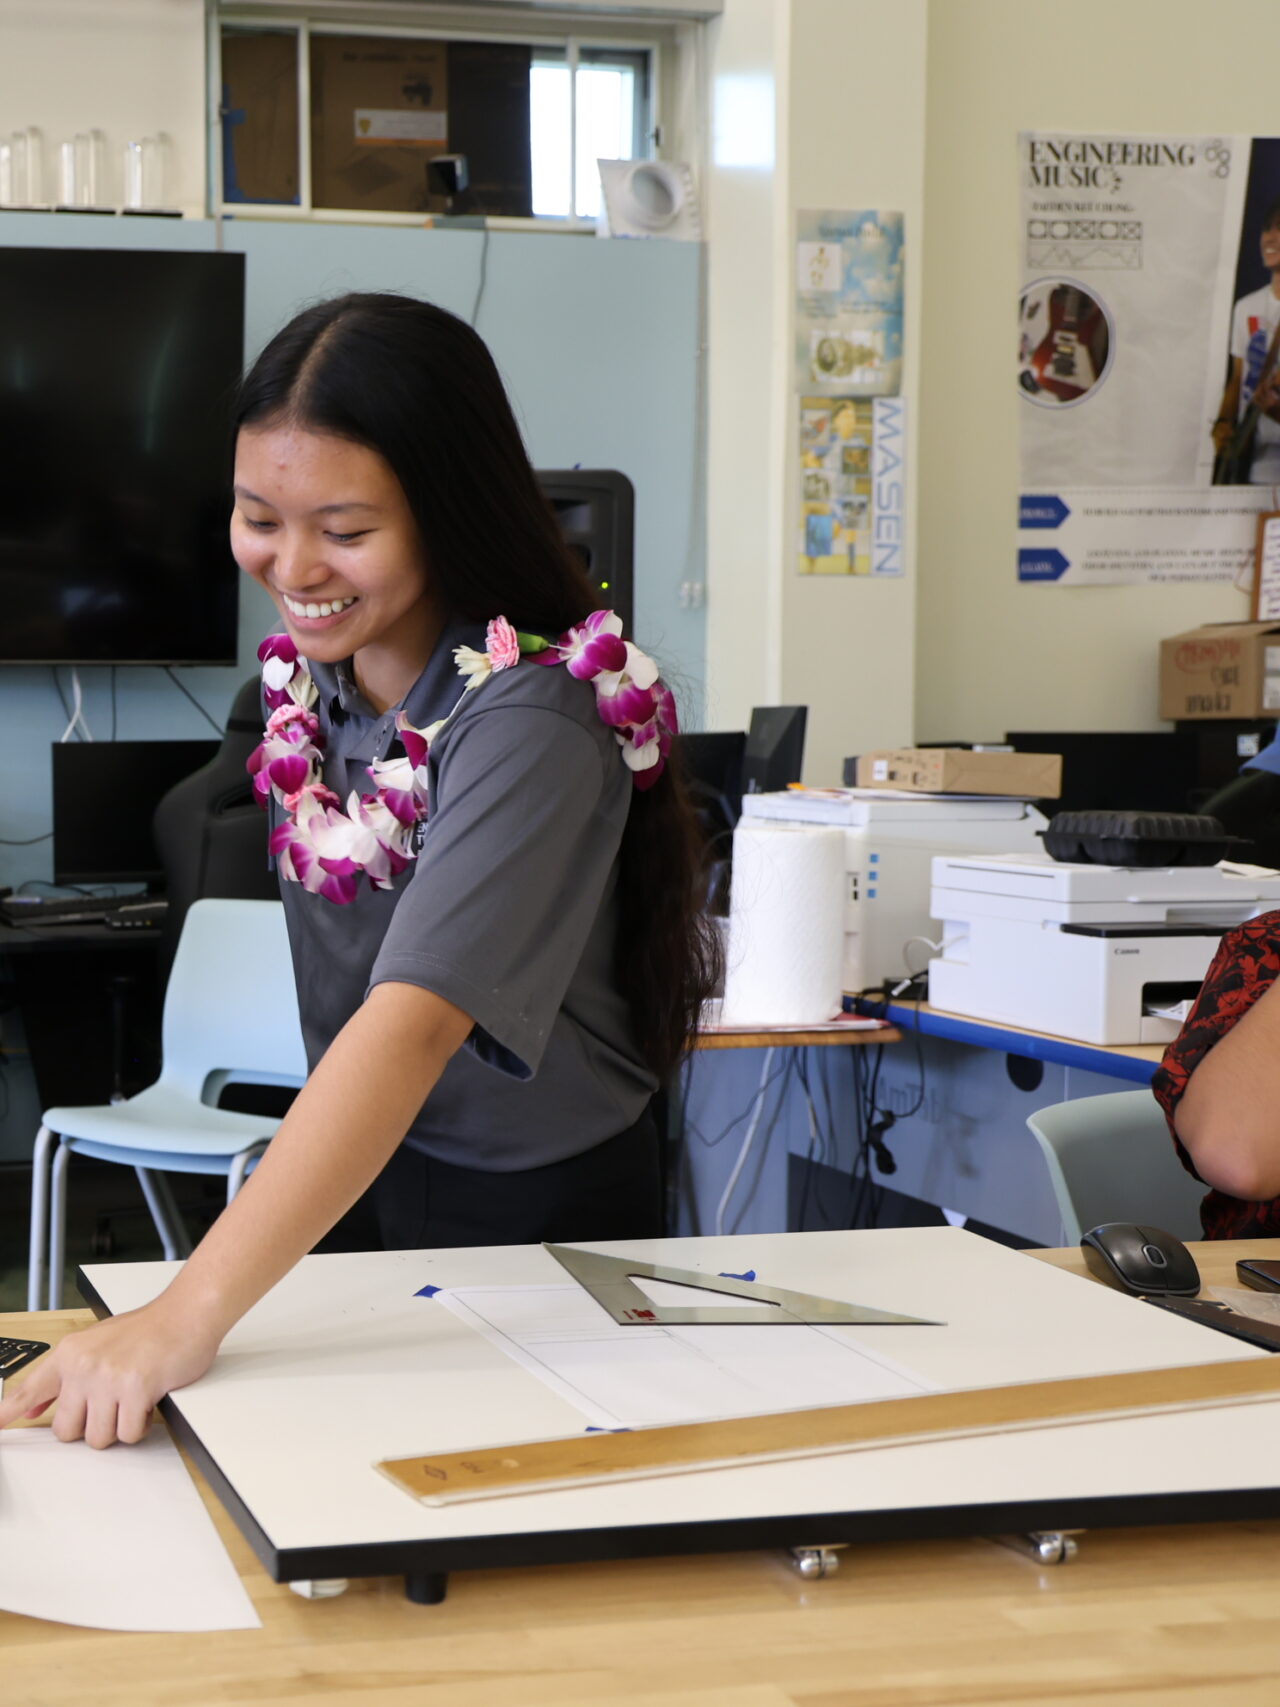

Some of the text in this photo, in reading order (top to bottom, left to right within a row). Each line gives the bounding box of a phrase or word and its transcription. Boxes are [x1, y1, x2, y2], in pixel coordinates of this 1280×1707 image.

[1029, 141, 1195, 166] ENGINEERING
[1029, 165, 1107, 188] MUSIC
[875, 402, 903, 574] MASEN
[1114, 948, 1140, 956] Canon
